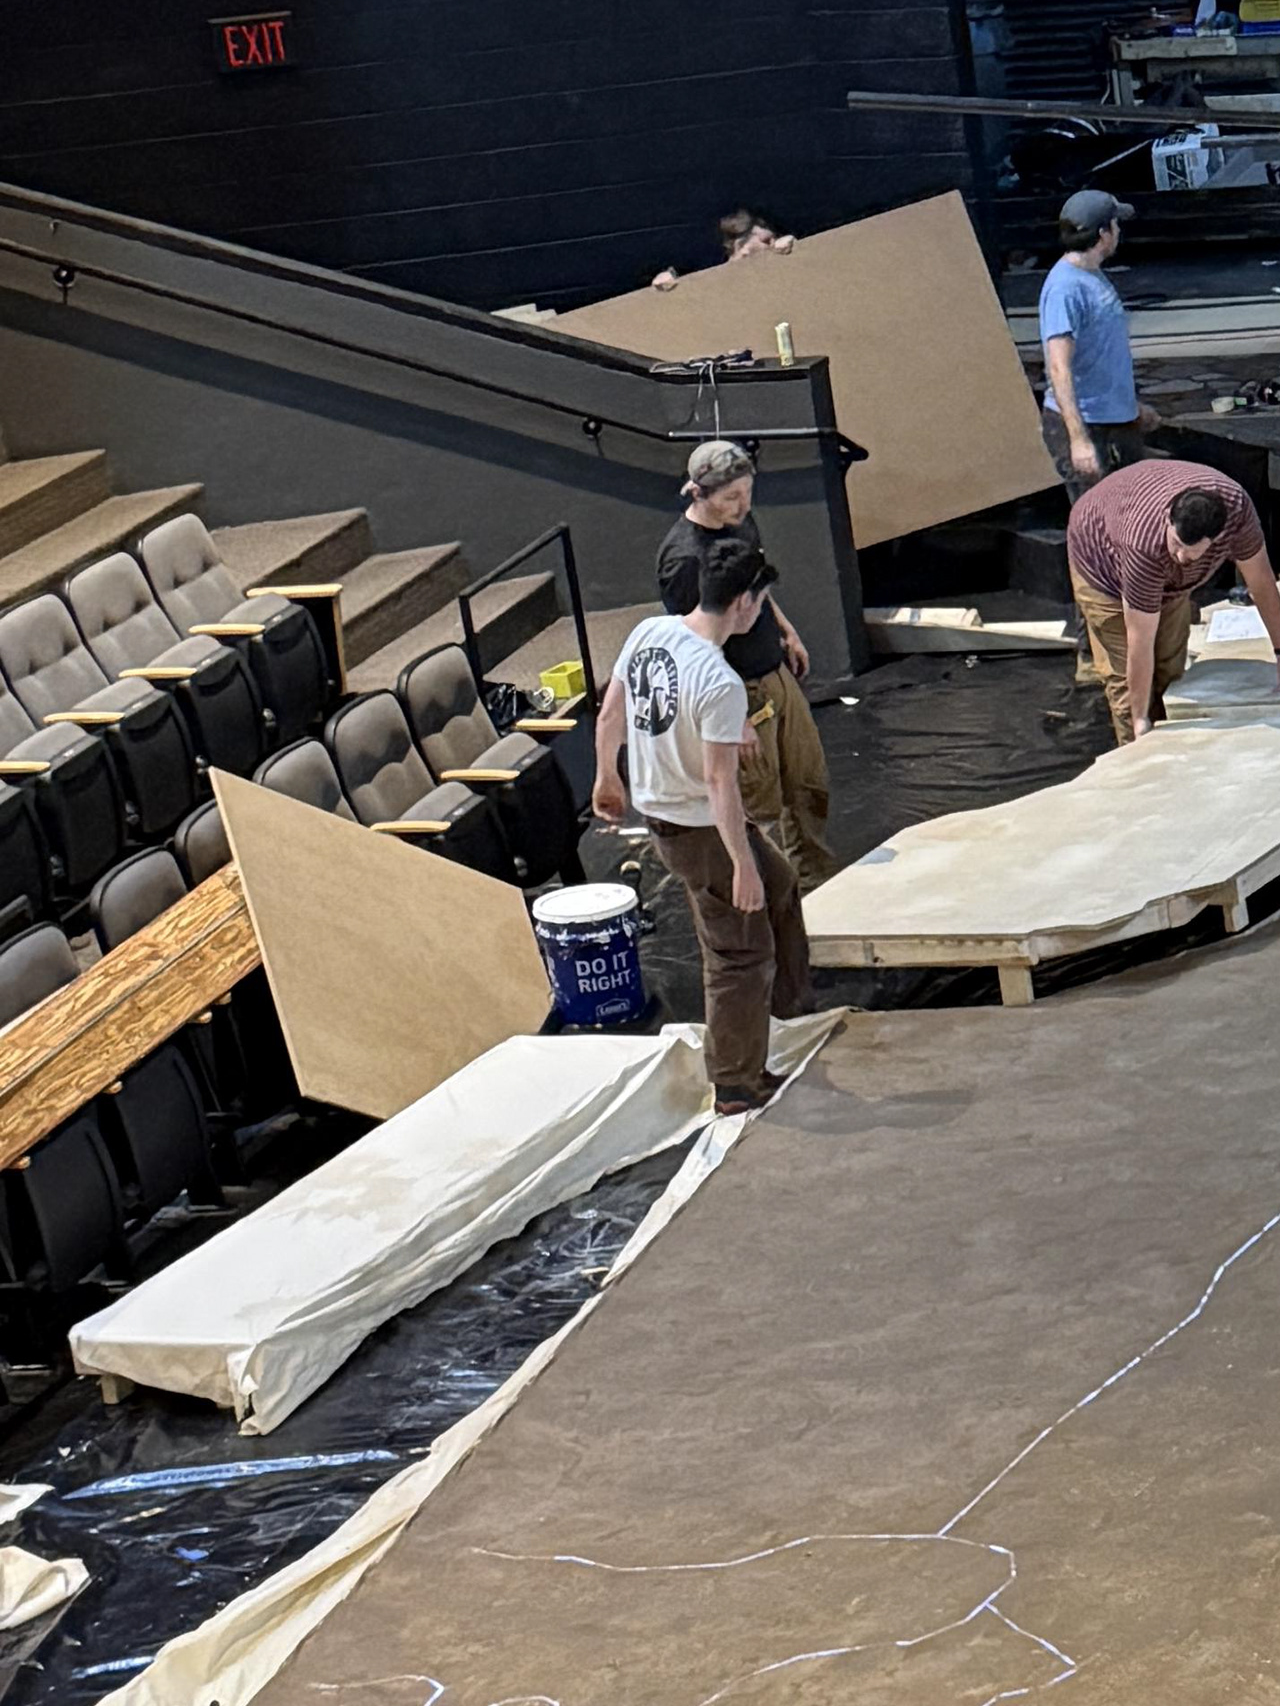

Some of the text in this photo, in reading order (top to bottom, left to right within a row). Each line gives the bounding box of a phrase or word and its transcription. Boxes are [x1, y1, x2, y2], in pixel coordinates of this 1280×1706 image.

[223, 21, 286, 67] EXIT
[575, 950, 629, 977] DO IT
[578, 968, 631, 993] RIGHT
